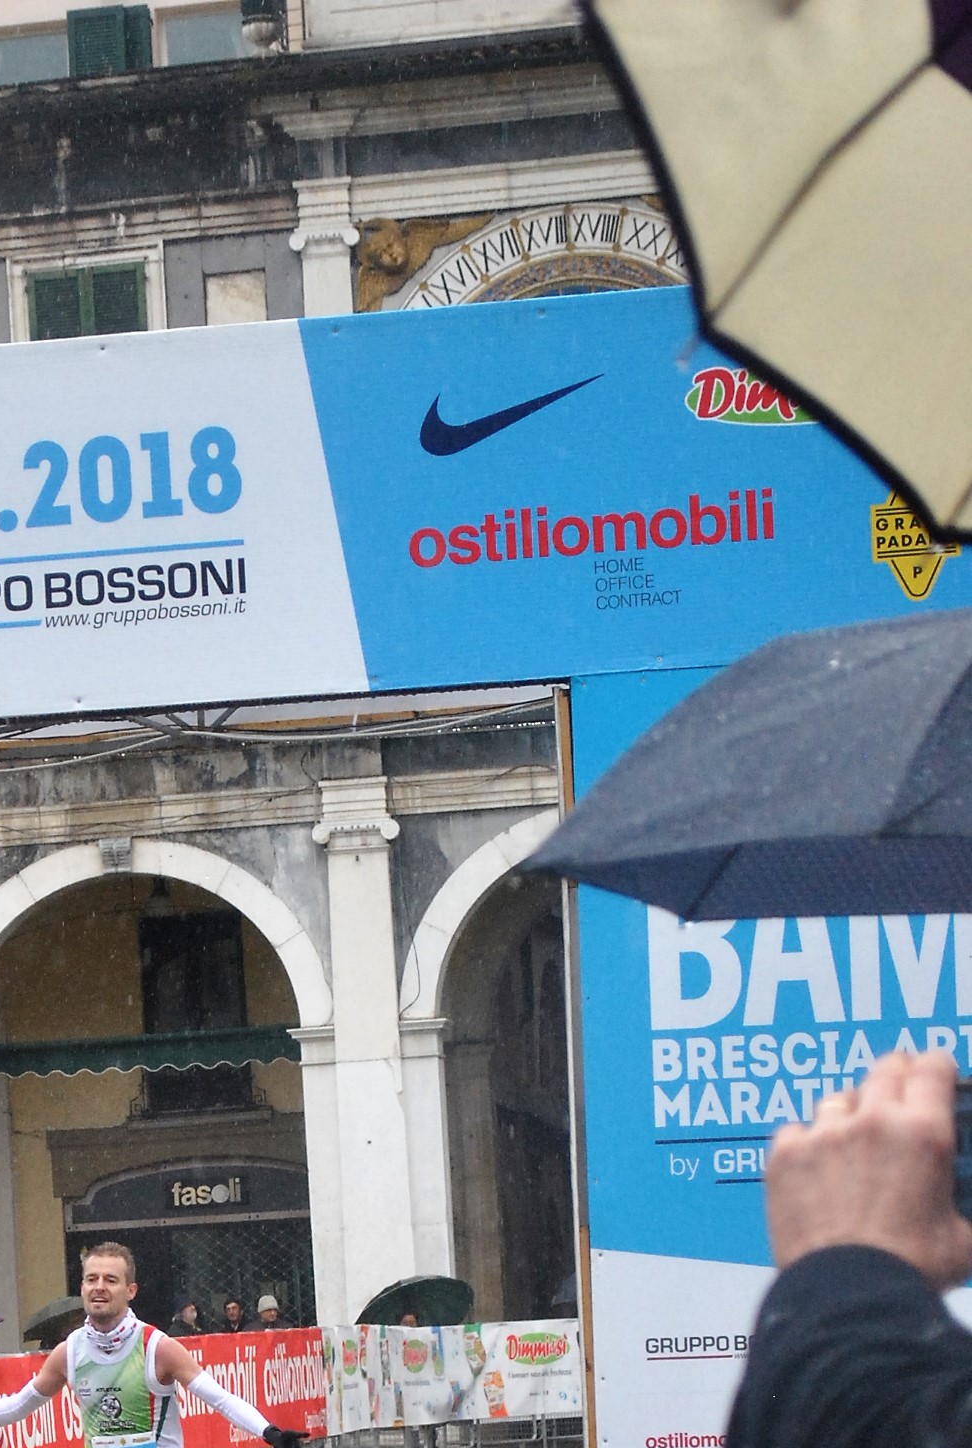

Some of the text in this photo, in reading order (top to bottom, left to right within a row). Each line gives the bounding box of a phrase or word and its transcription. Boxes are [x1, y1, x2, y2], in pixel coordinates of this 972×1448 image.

[473, 228, 521, 273] XVII
[625, 217, 666, 256] XX
[694, 366, 797, 421] Dim
[409, 487, 775, 568] ostiliomobili
[875, 517, 922, 531] GRA
[876, 534, 930, 549] PADA
[593, 557, 645, 574] HOME
[913, 567, 923, 579] P
[44, 558, 247, 609] BOSSONI
[594, 574, 656, 592] OFFICE
[44, 599, 247, 630] www.gruppobossoni.it
[595, 590, 682, 611] CONTRACT
[652, 1029, 876, 1082] BRESCIA
[670, 1154, 700, 1181] by
[171, 1177, 242, 1206] fasoli
[645, 1335, 730, 1354] GRUPPO
